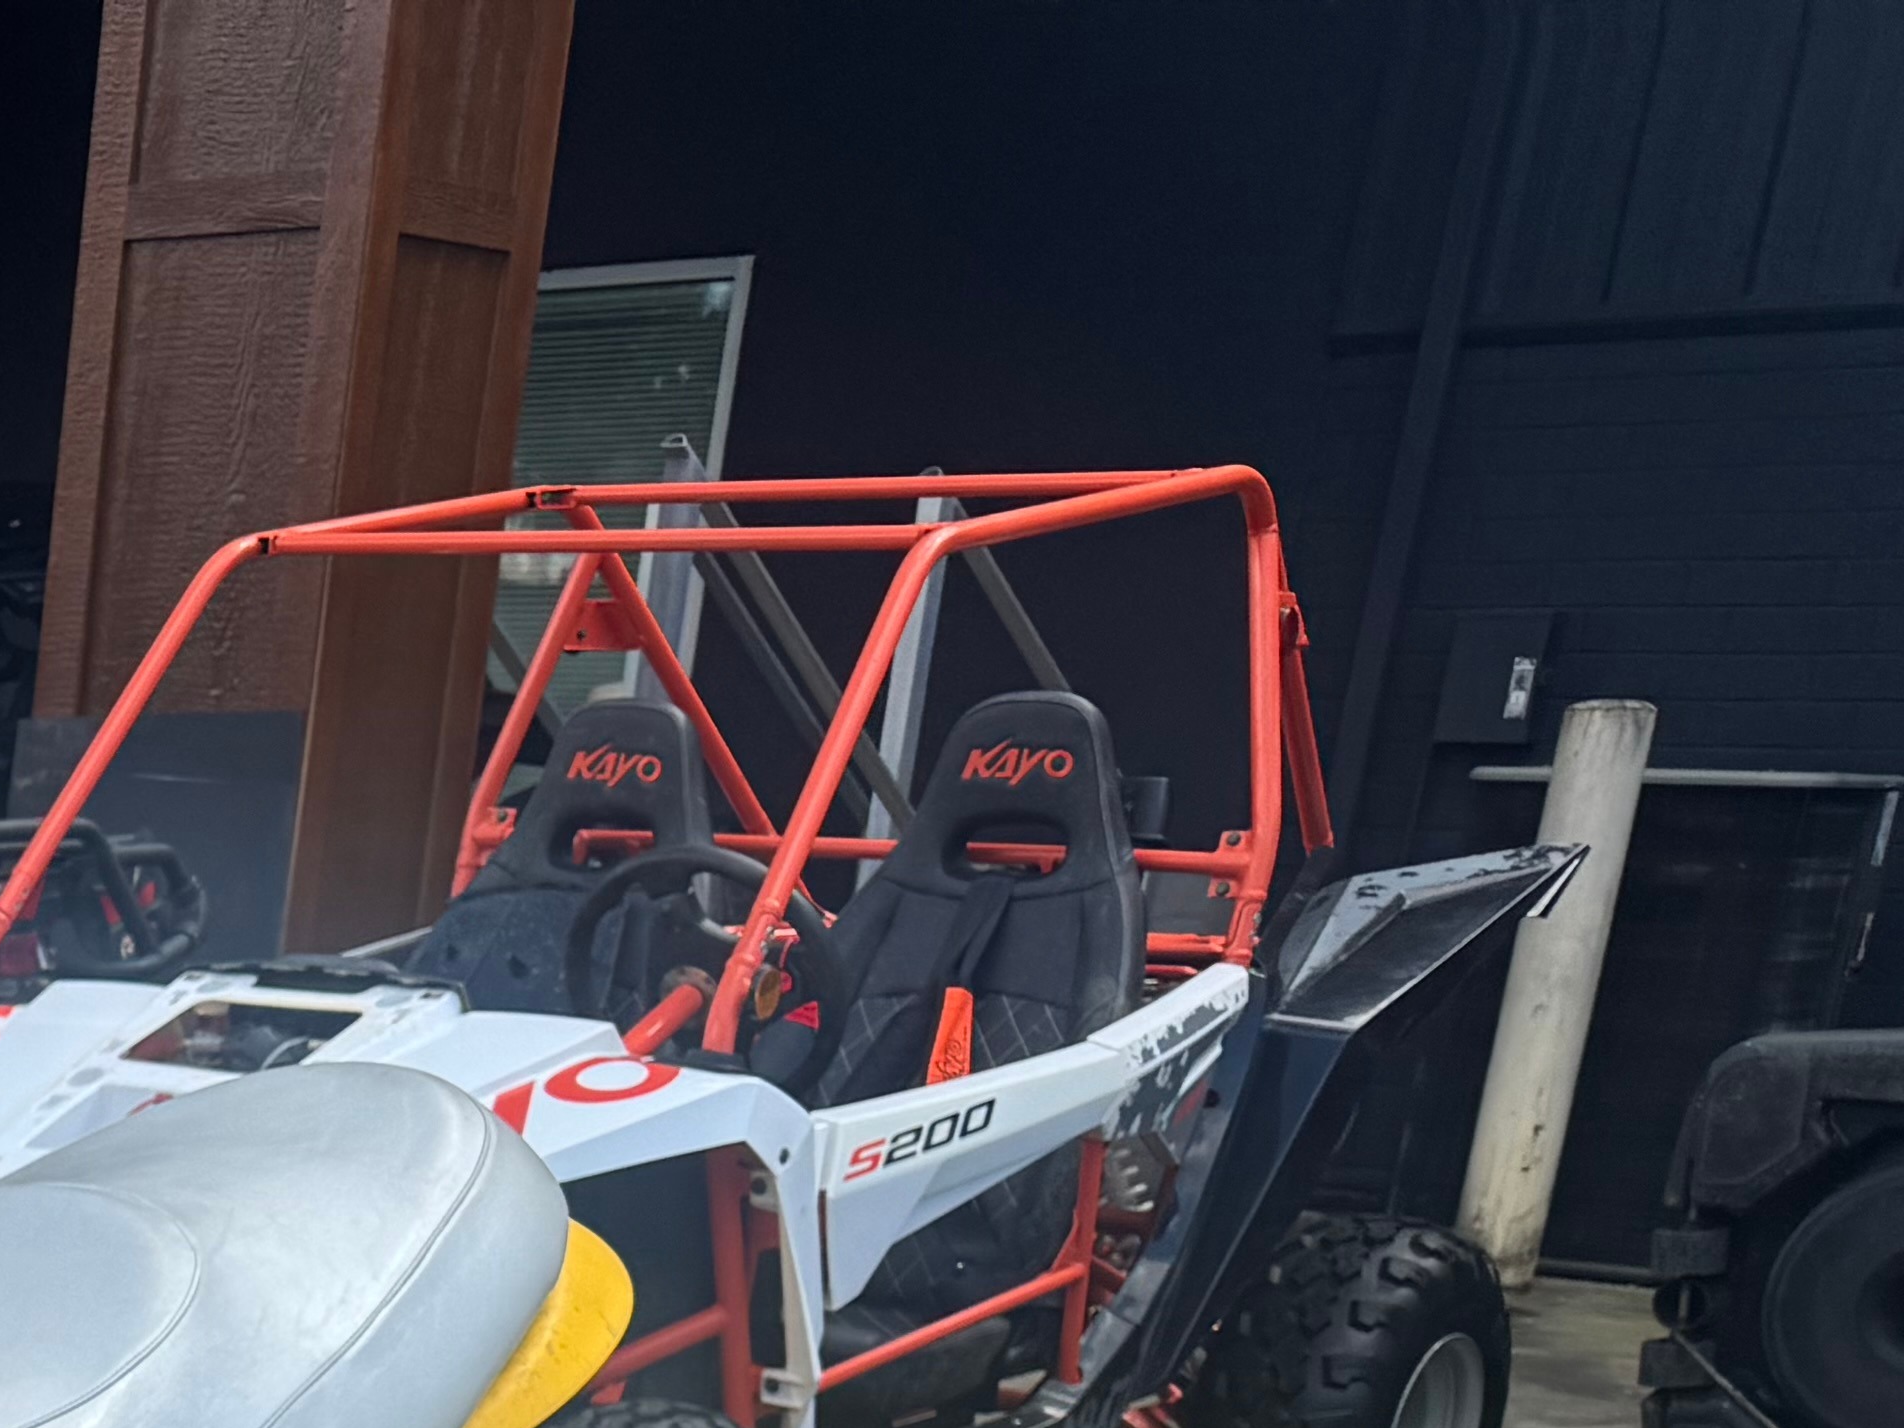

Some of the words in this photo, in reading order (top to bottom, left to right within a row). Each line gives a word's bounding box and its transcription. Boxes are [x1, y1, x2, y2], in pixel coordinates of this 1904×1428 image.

[566, 742, 663, 787] KAYO
[961, 738, 1074, 786] KAYO
[844, 1098, 996, 1182] S200
